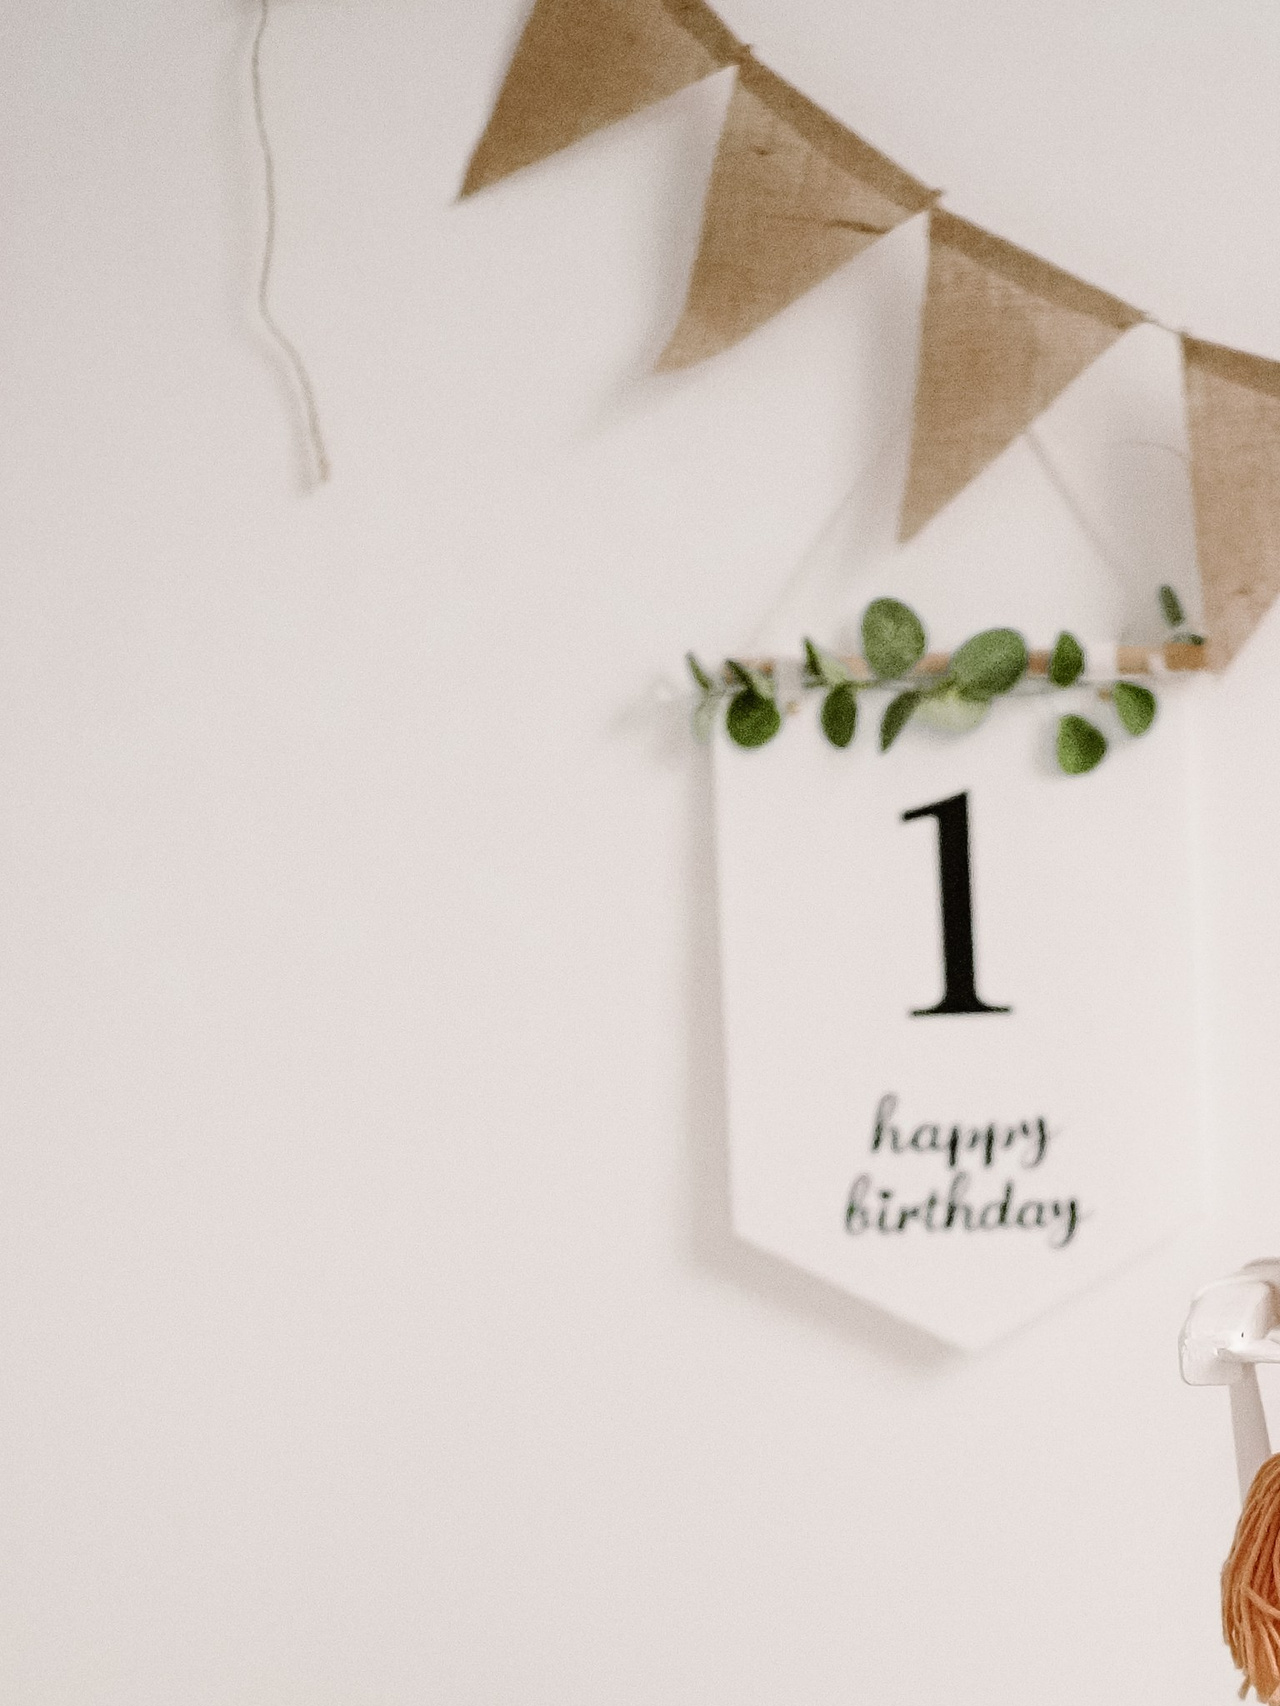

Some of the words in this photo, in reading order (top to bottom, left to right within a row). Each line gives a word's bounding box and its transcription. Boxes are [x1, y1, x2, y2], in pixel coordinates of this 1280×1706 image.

[899, 789, 1013, 1019] 1
[870, 1092, 1058, 1169] happy
[845, 1172, 1087, 1249] birthday
